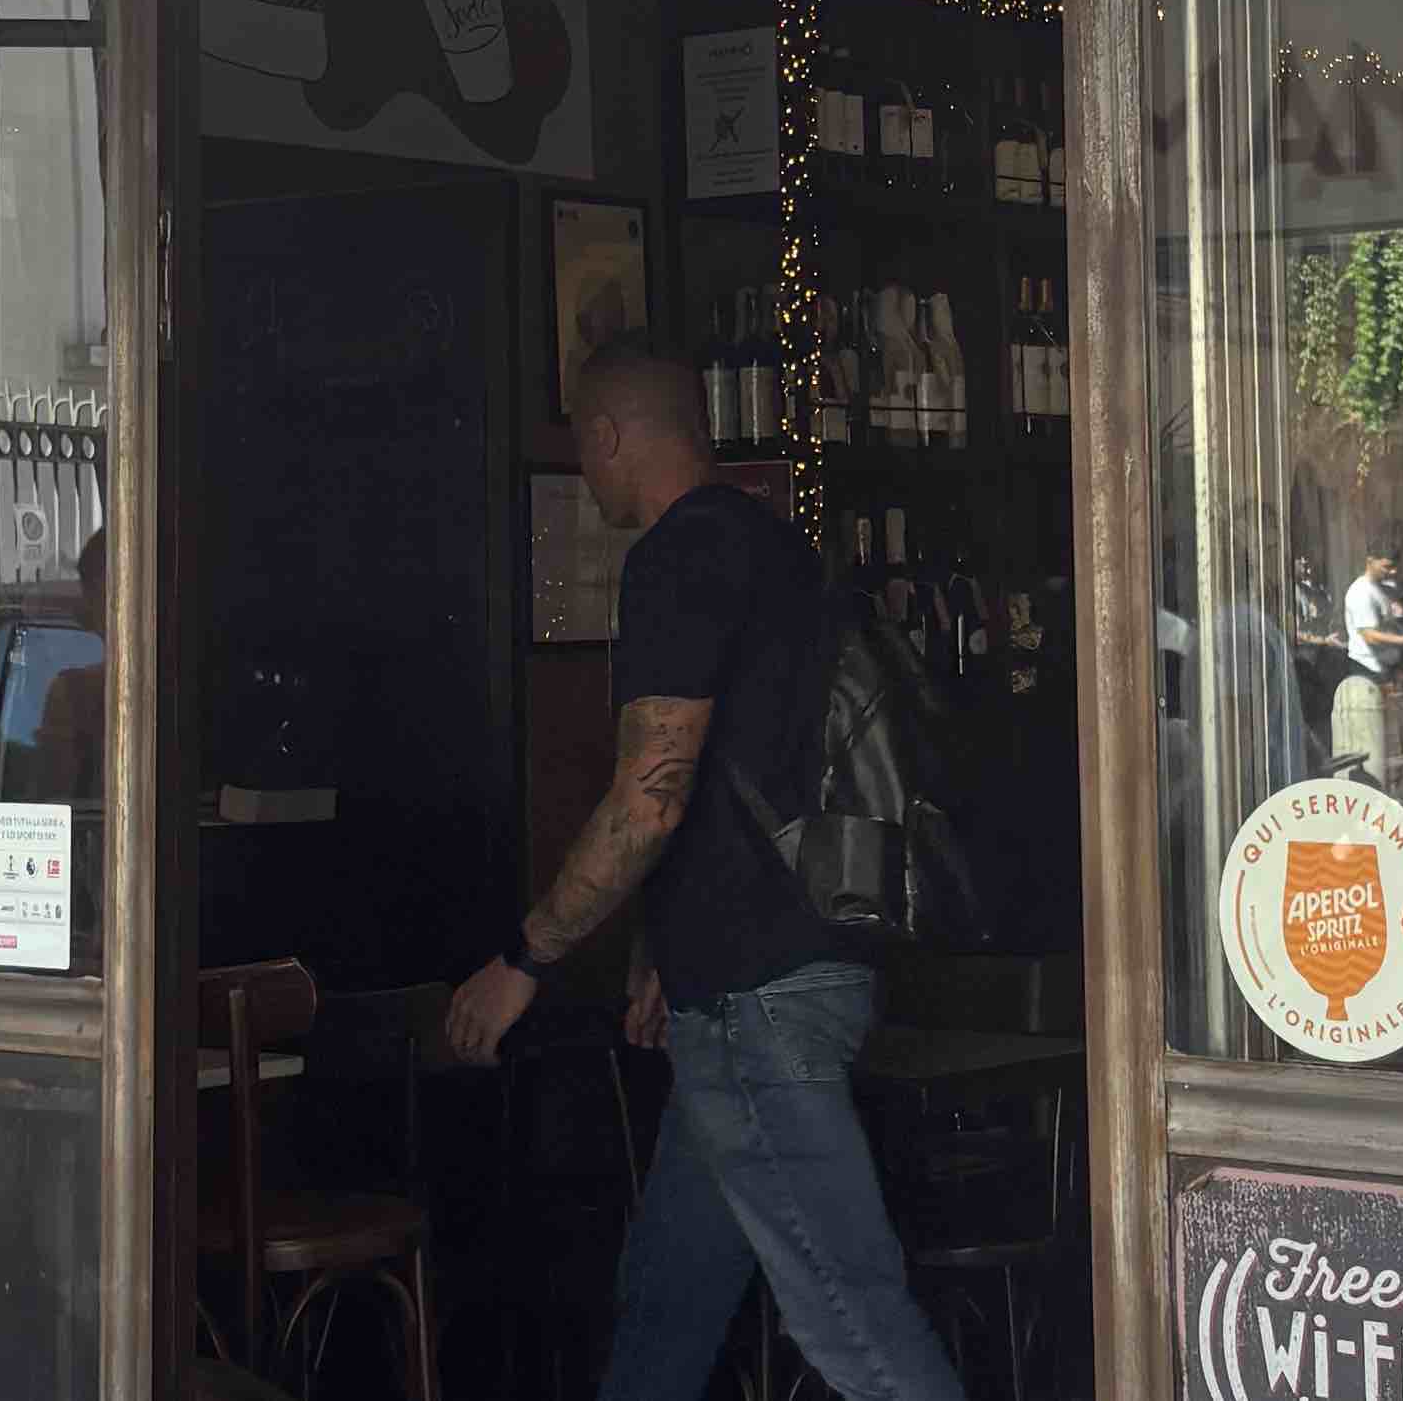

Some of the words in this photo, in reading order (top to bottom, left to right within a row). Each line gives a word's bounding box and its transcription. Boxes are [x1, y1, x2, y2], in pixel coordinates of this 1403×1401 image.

[1242, 819, 1283, 866] QUI
[1287, 882, 1380, 925] APEROL
[1300, 936, 1380, 957] L'ORIGINALE
[1307, 915, 1363, 943] SPRITZ
